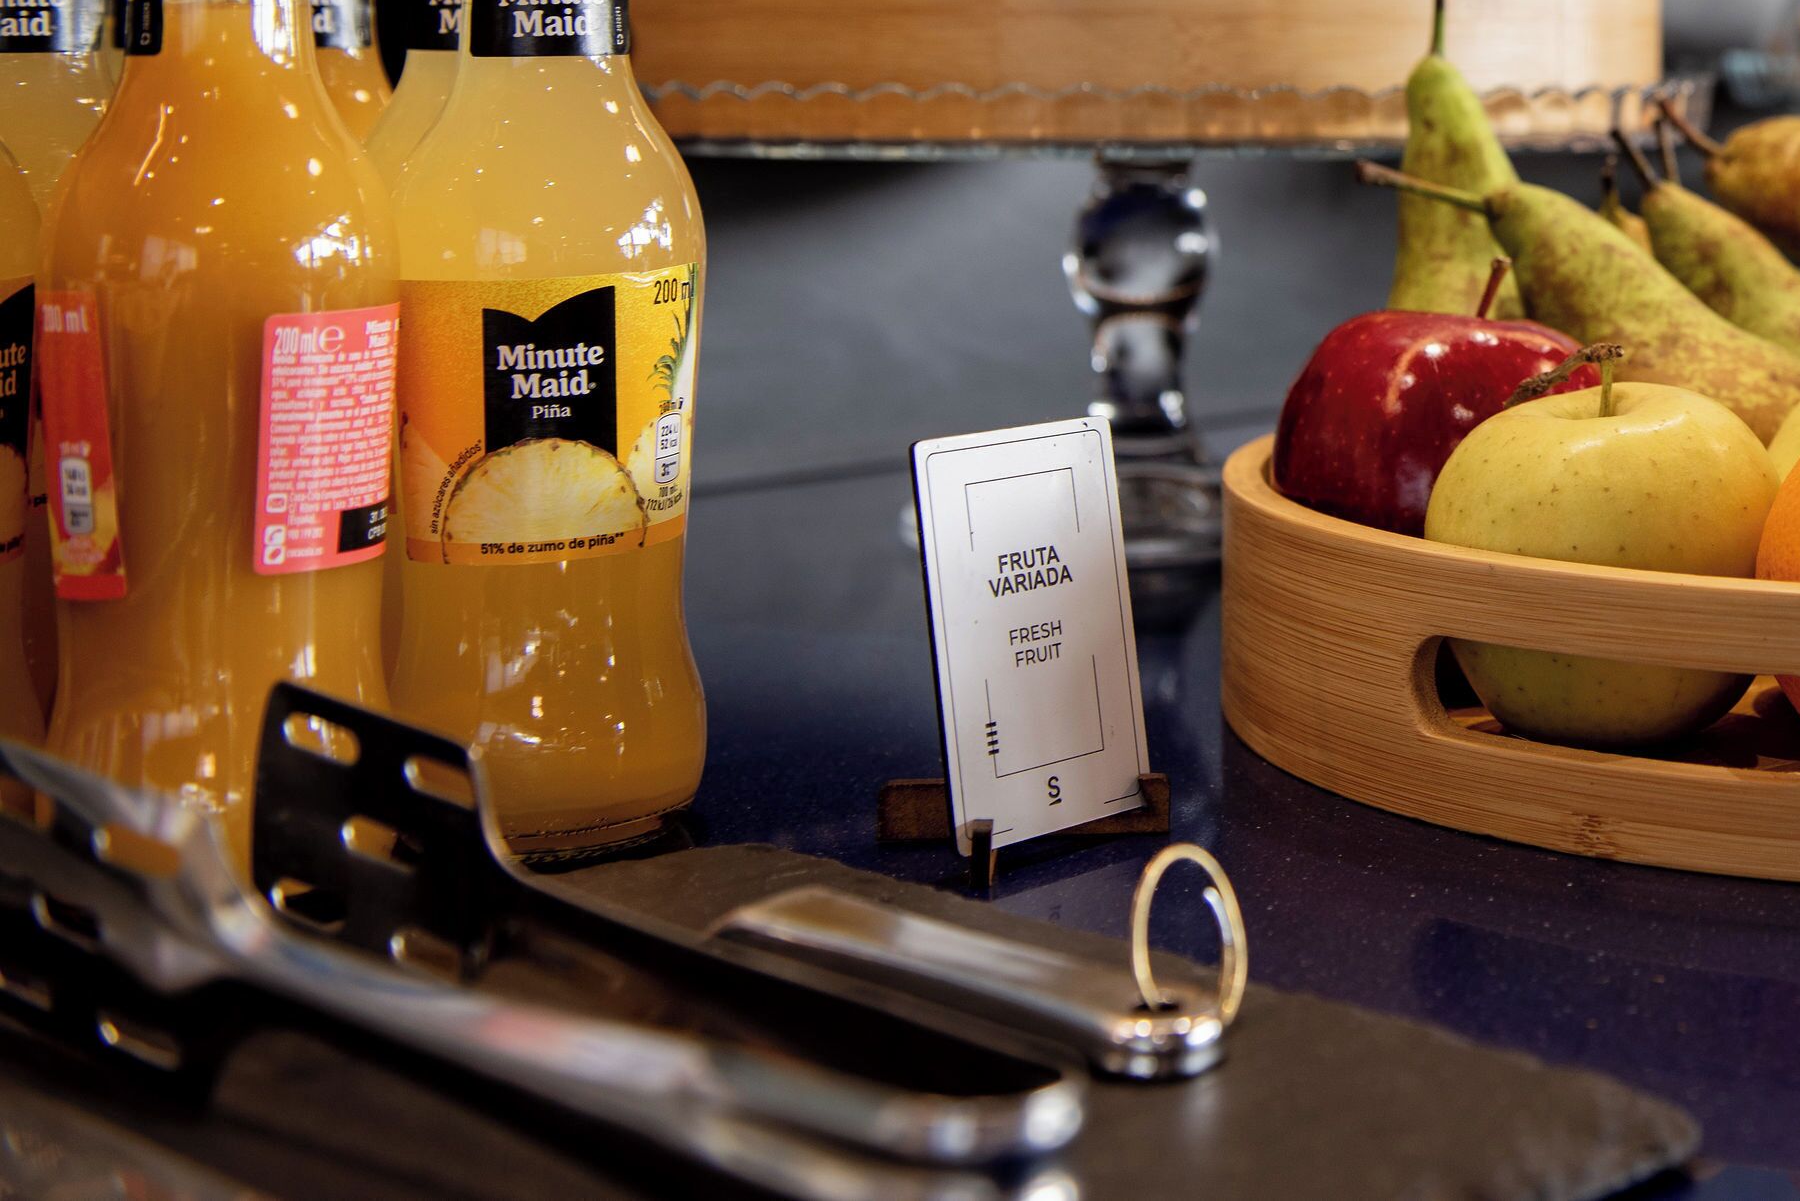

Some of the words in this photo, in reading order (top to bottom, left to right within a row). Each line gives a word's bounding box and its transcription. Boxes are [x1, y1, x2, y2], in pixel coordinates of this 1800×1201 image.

[513, 7, 594, 38] Maid
[653, 277, 678, 305] 200
[273, 326, 299, 354] 200
[496, 342, 605, 371] Minute
[511, 370, 590, 400] Maid
[532, 404, 572, 420] Piña
[480, 542, 504, 555] 51%
[507, 542, 525, 554] de
[527, 540, 565, 553] zumo
[565, 537, 585, 549] de
[997, 545, 1060, 574] FRUTA
[988, 564, 1073, 598] VARIADA
[1009, 620, 1063, 646] FRESH
[1015, 642, 1063, 668] FRUIT
